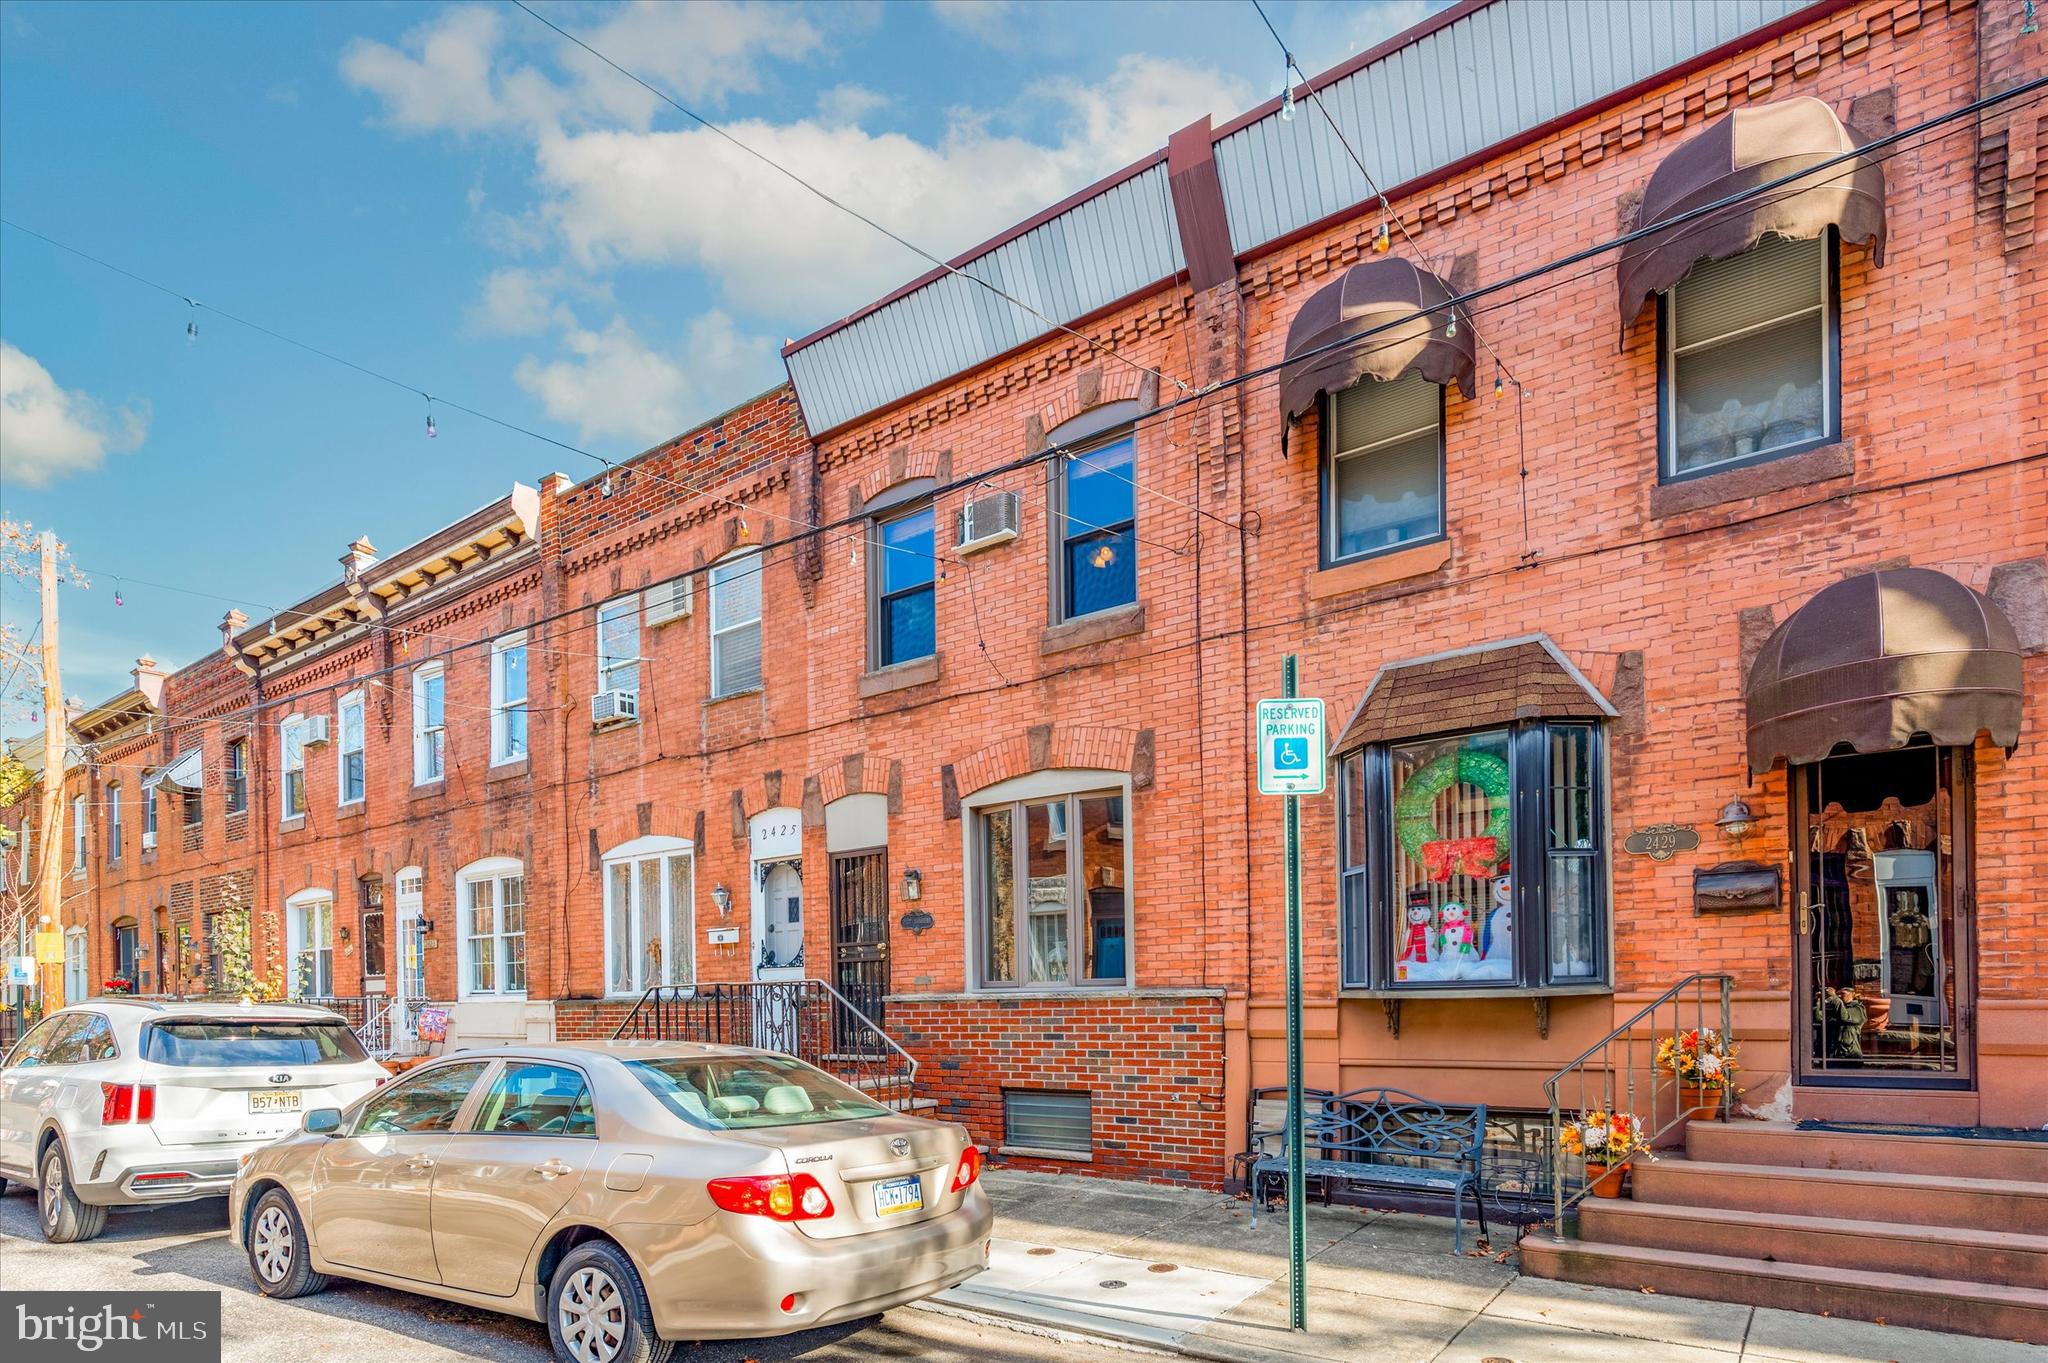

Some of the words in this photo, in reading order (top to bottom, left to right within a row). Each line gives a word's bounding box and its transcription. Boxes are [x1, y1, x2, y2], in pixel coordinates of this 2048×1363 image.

[1262, 706, 1319, 720] RESERVED
[1266, 722, 1316, 736] PARKING
[761, 824, 797, 840] 2425
[1645, 834, 1676, 850] 2429
[271, 1073, 290, 1082] KIA
[795, 1154, 833, 1164] COROLLA
